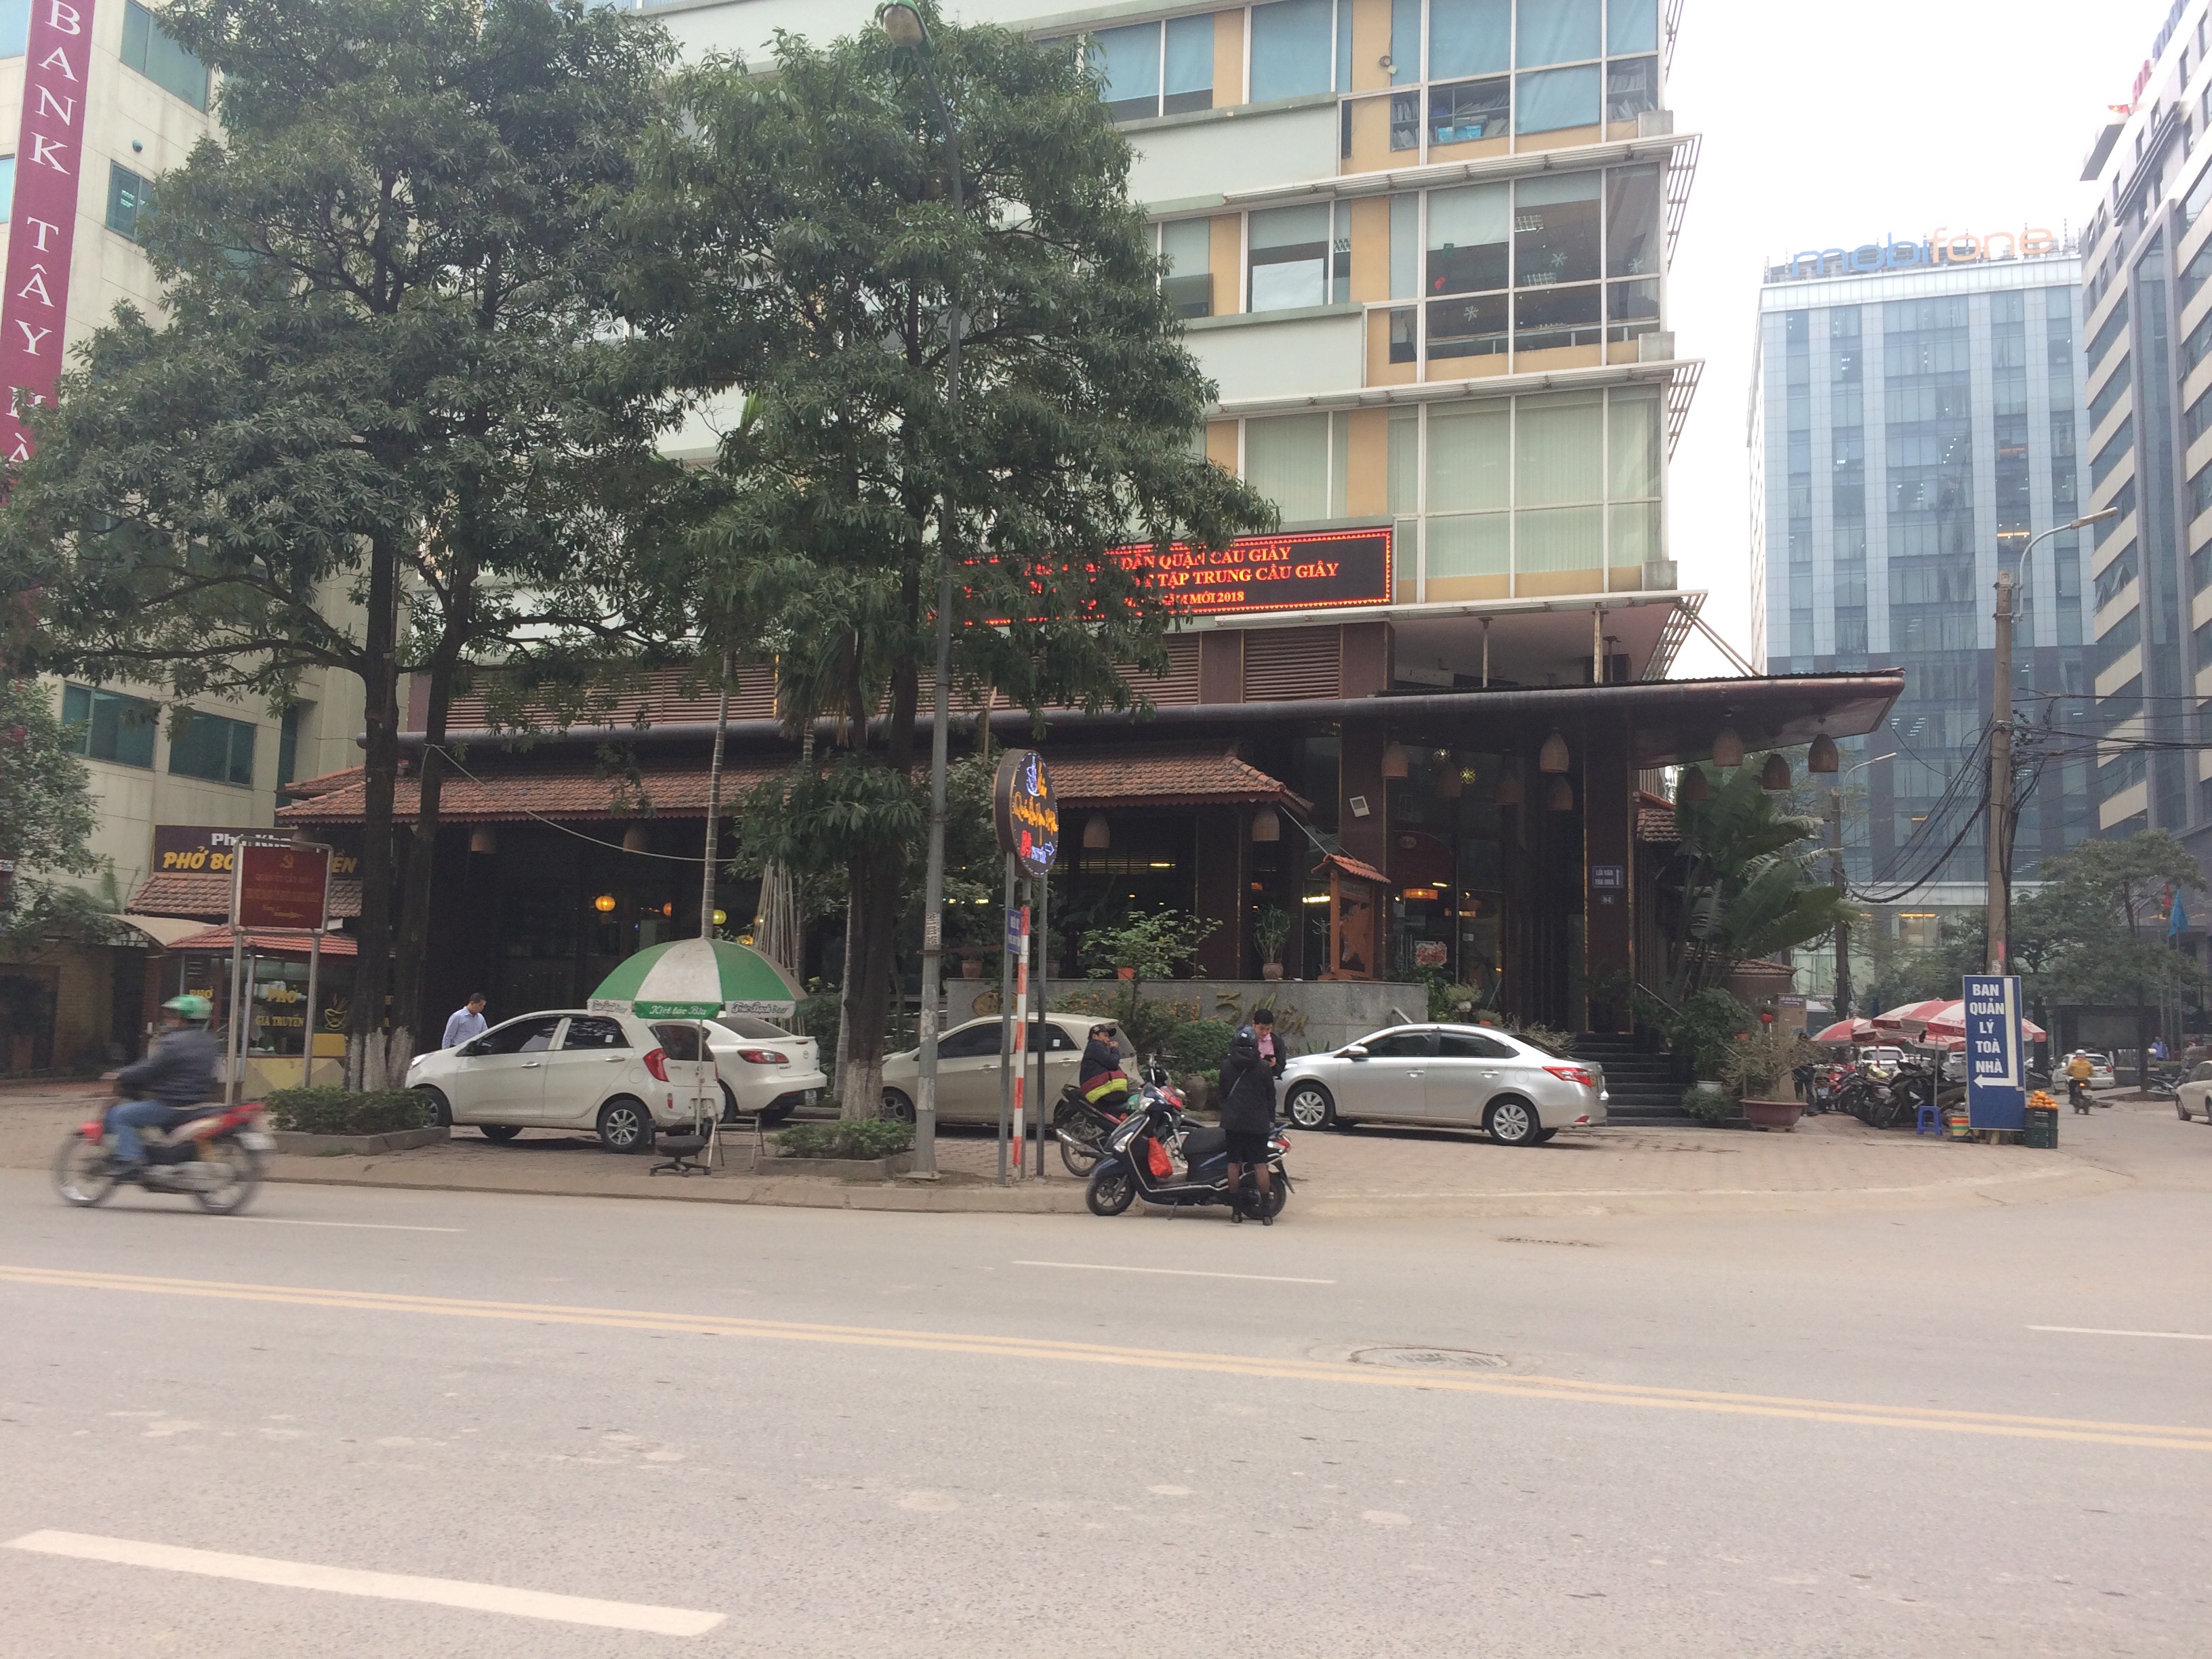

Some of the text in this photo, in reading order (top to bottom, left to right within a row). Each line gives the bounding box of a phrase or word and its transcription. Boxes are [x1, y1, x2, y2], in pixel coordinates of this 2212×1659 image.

[30, 0, 81, 174] BANK
[1792, 226, 2053, 276] mobifone
[12, 216, 59, 356] TÂY
[1248, 544, 1292, 563] GIẤY
[1156, 571, 1190, 590] TẬP
[1192, 568, 1252, 585] TRUNG
[1294, 560, 1339, 578] GIẤY
[1189, 590, 1216, 604] MỚI
[1216, 591, 1244, 603] 2018
[163, 846, 209, 870] PHỞ
[1972, 984, 1999, 996] BAN
[1969, 998, 2005, 1015] QUẢN
[1979, 1019, 1994, 1034] LÝ
[1975, 1038, 2001, 1053] TOÀ
[1975, 1058, 2003, 1073] NHÀ
